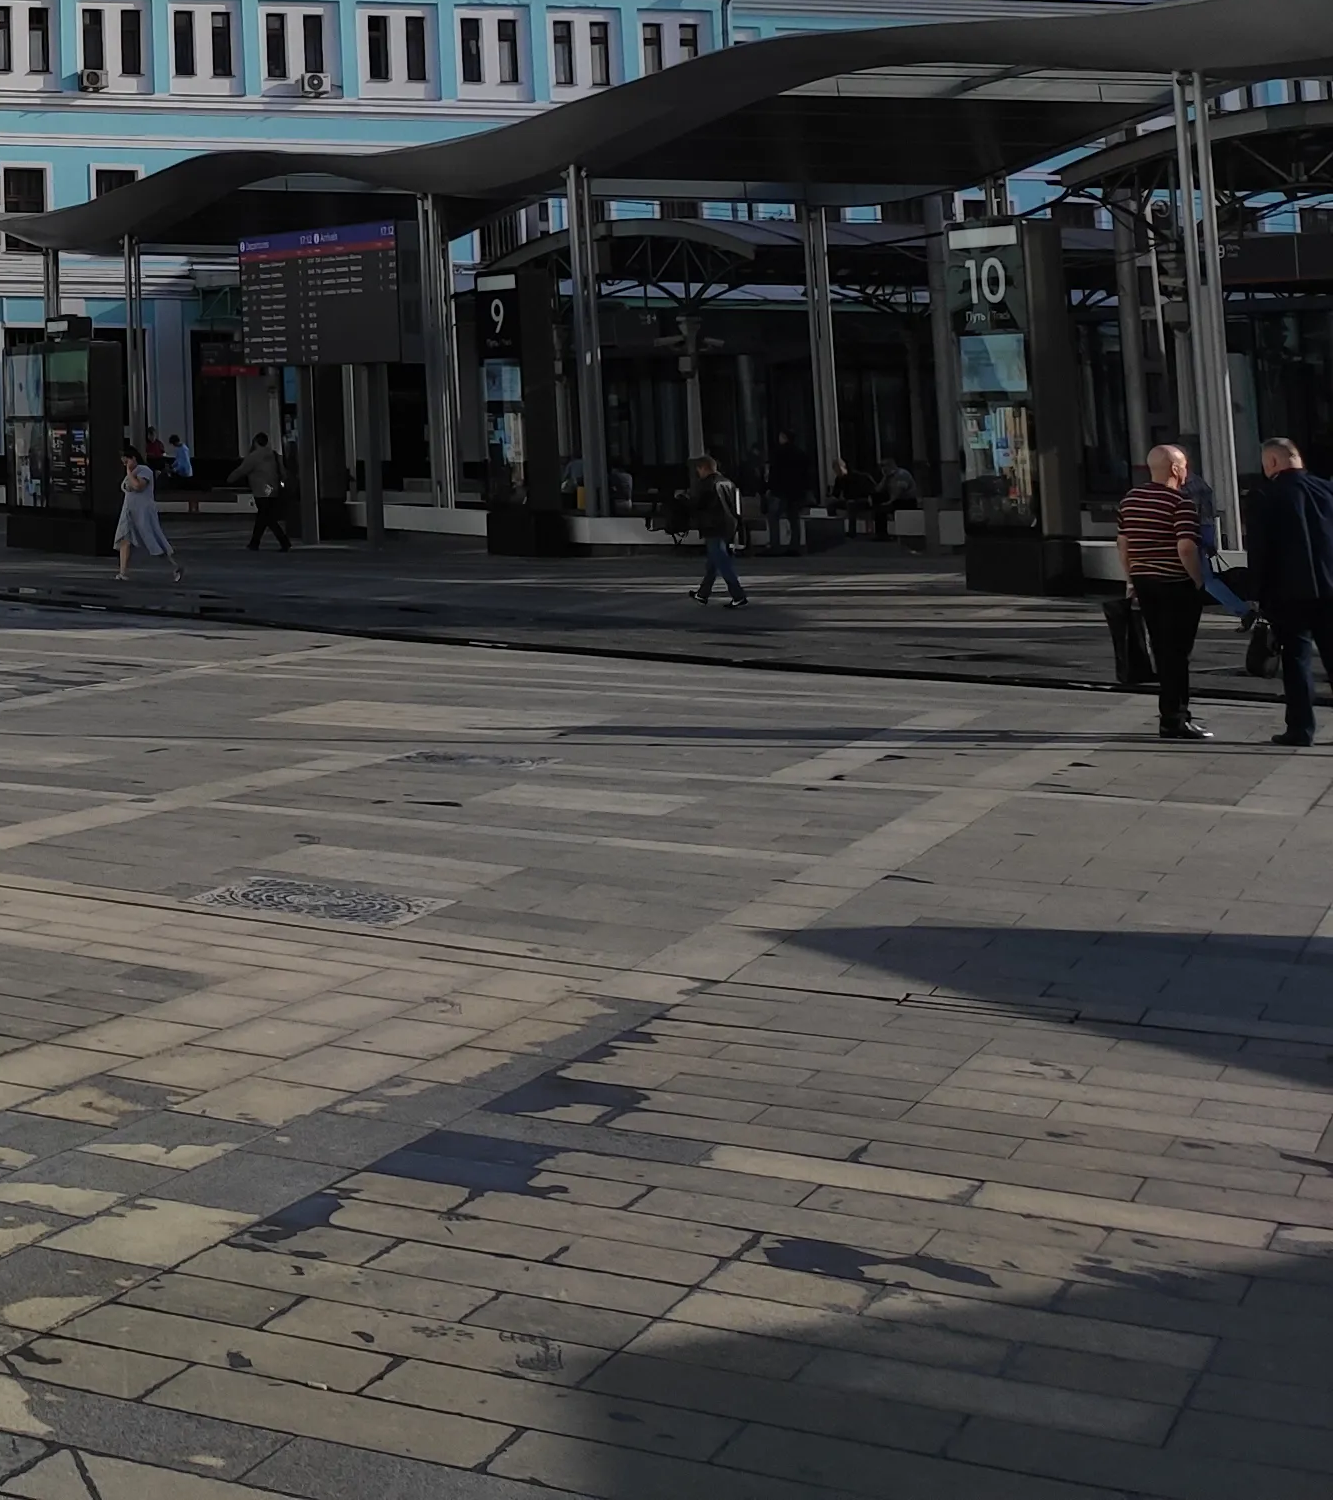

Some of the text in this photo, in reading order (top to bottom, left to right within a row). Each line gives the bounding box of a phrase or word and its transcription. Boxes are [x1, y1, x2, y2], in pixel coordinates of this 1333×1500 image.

[964, 256, 1006, 304] 10
[490, 298, 505, 334] 9
[965, 311, 986, 323] Путь
